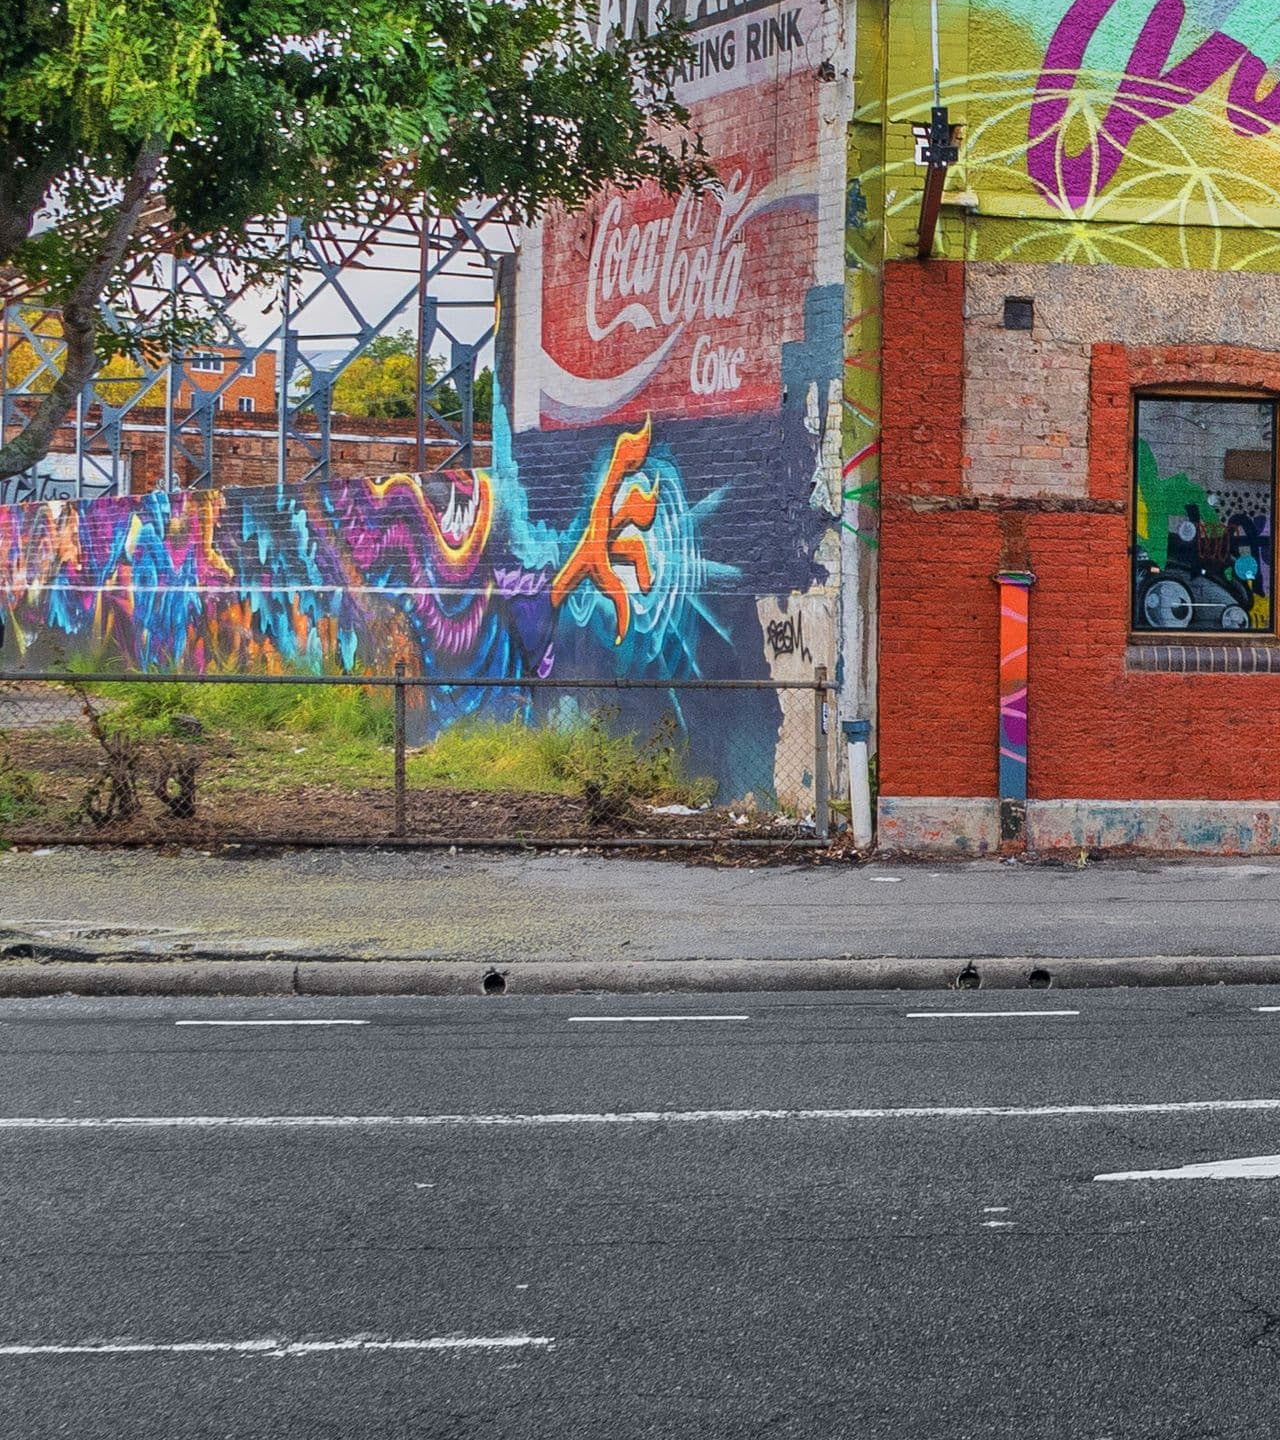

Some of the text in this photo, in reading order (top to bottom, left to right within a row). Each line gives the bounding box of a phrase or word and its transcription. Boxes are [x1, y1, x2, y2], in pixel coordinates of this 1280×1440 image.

[746, 8, 804, 63] RINK
[586, 168, 753, 342] Coca-Cola
[690, 335, 745, 395] Coke
